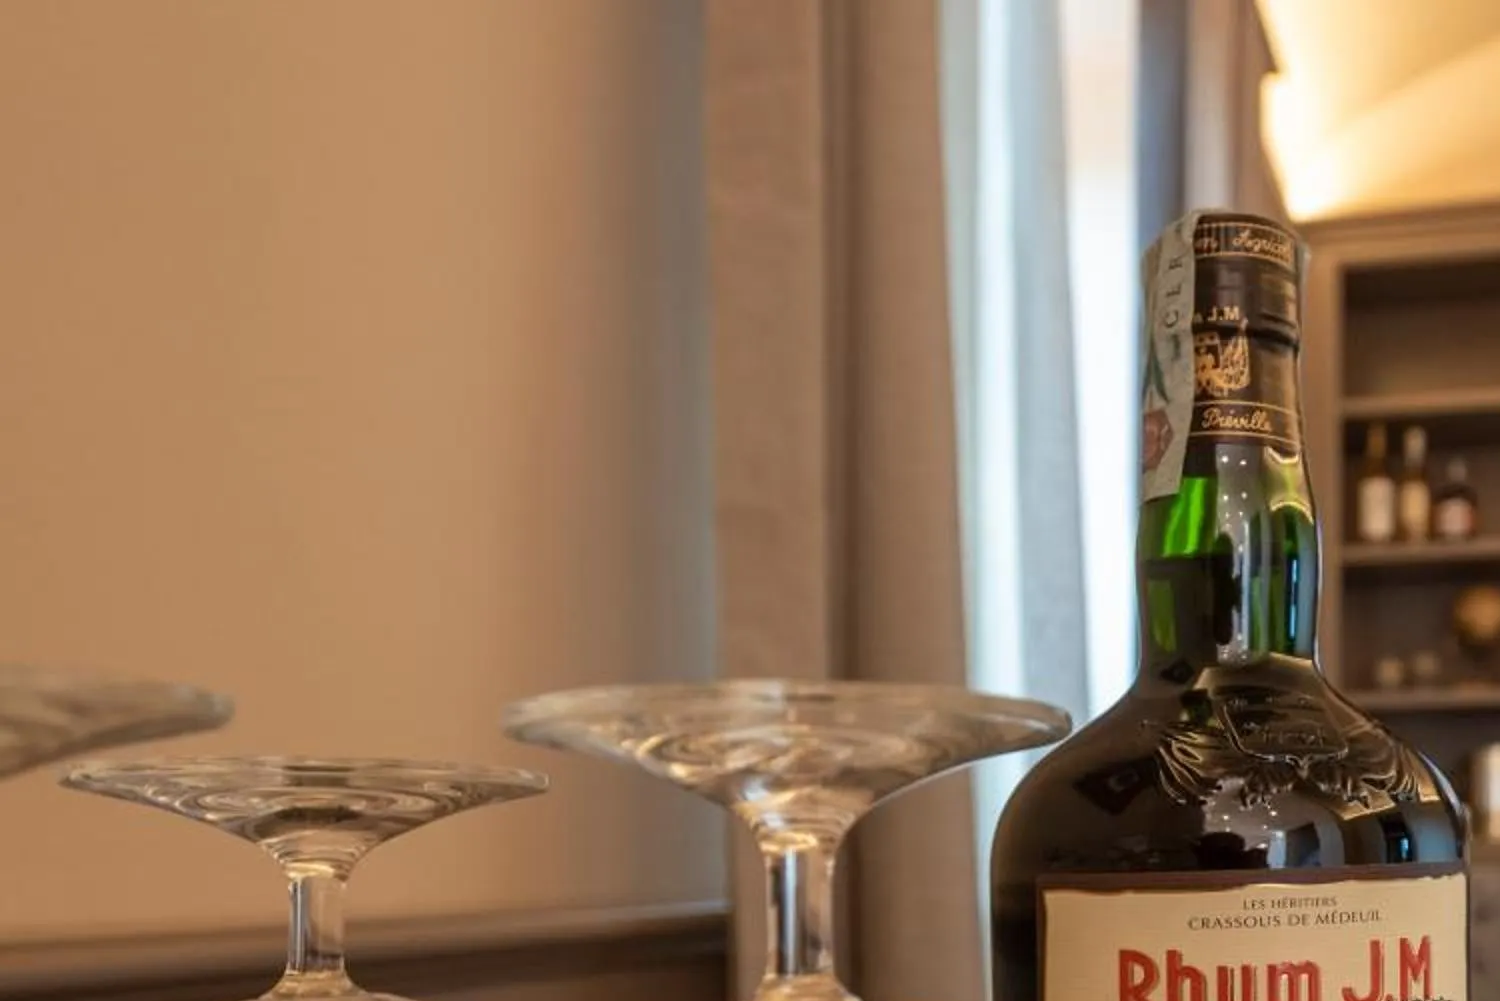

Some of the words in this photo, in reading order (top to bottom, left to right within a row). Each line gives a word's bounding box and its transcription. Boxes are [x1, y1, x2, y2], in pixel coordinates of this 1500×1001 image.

[1242, 898, 1266, 911] LES
[1187, 913, 1282, 931] CRASSOUS
[1287, 912, 1312, 927] DE
